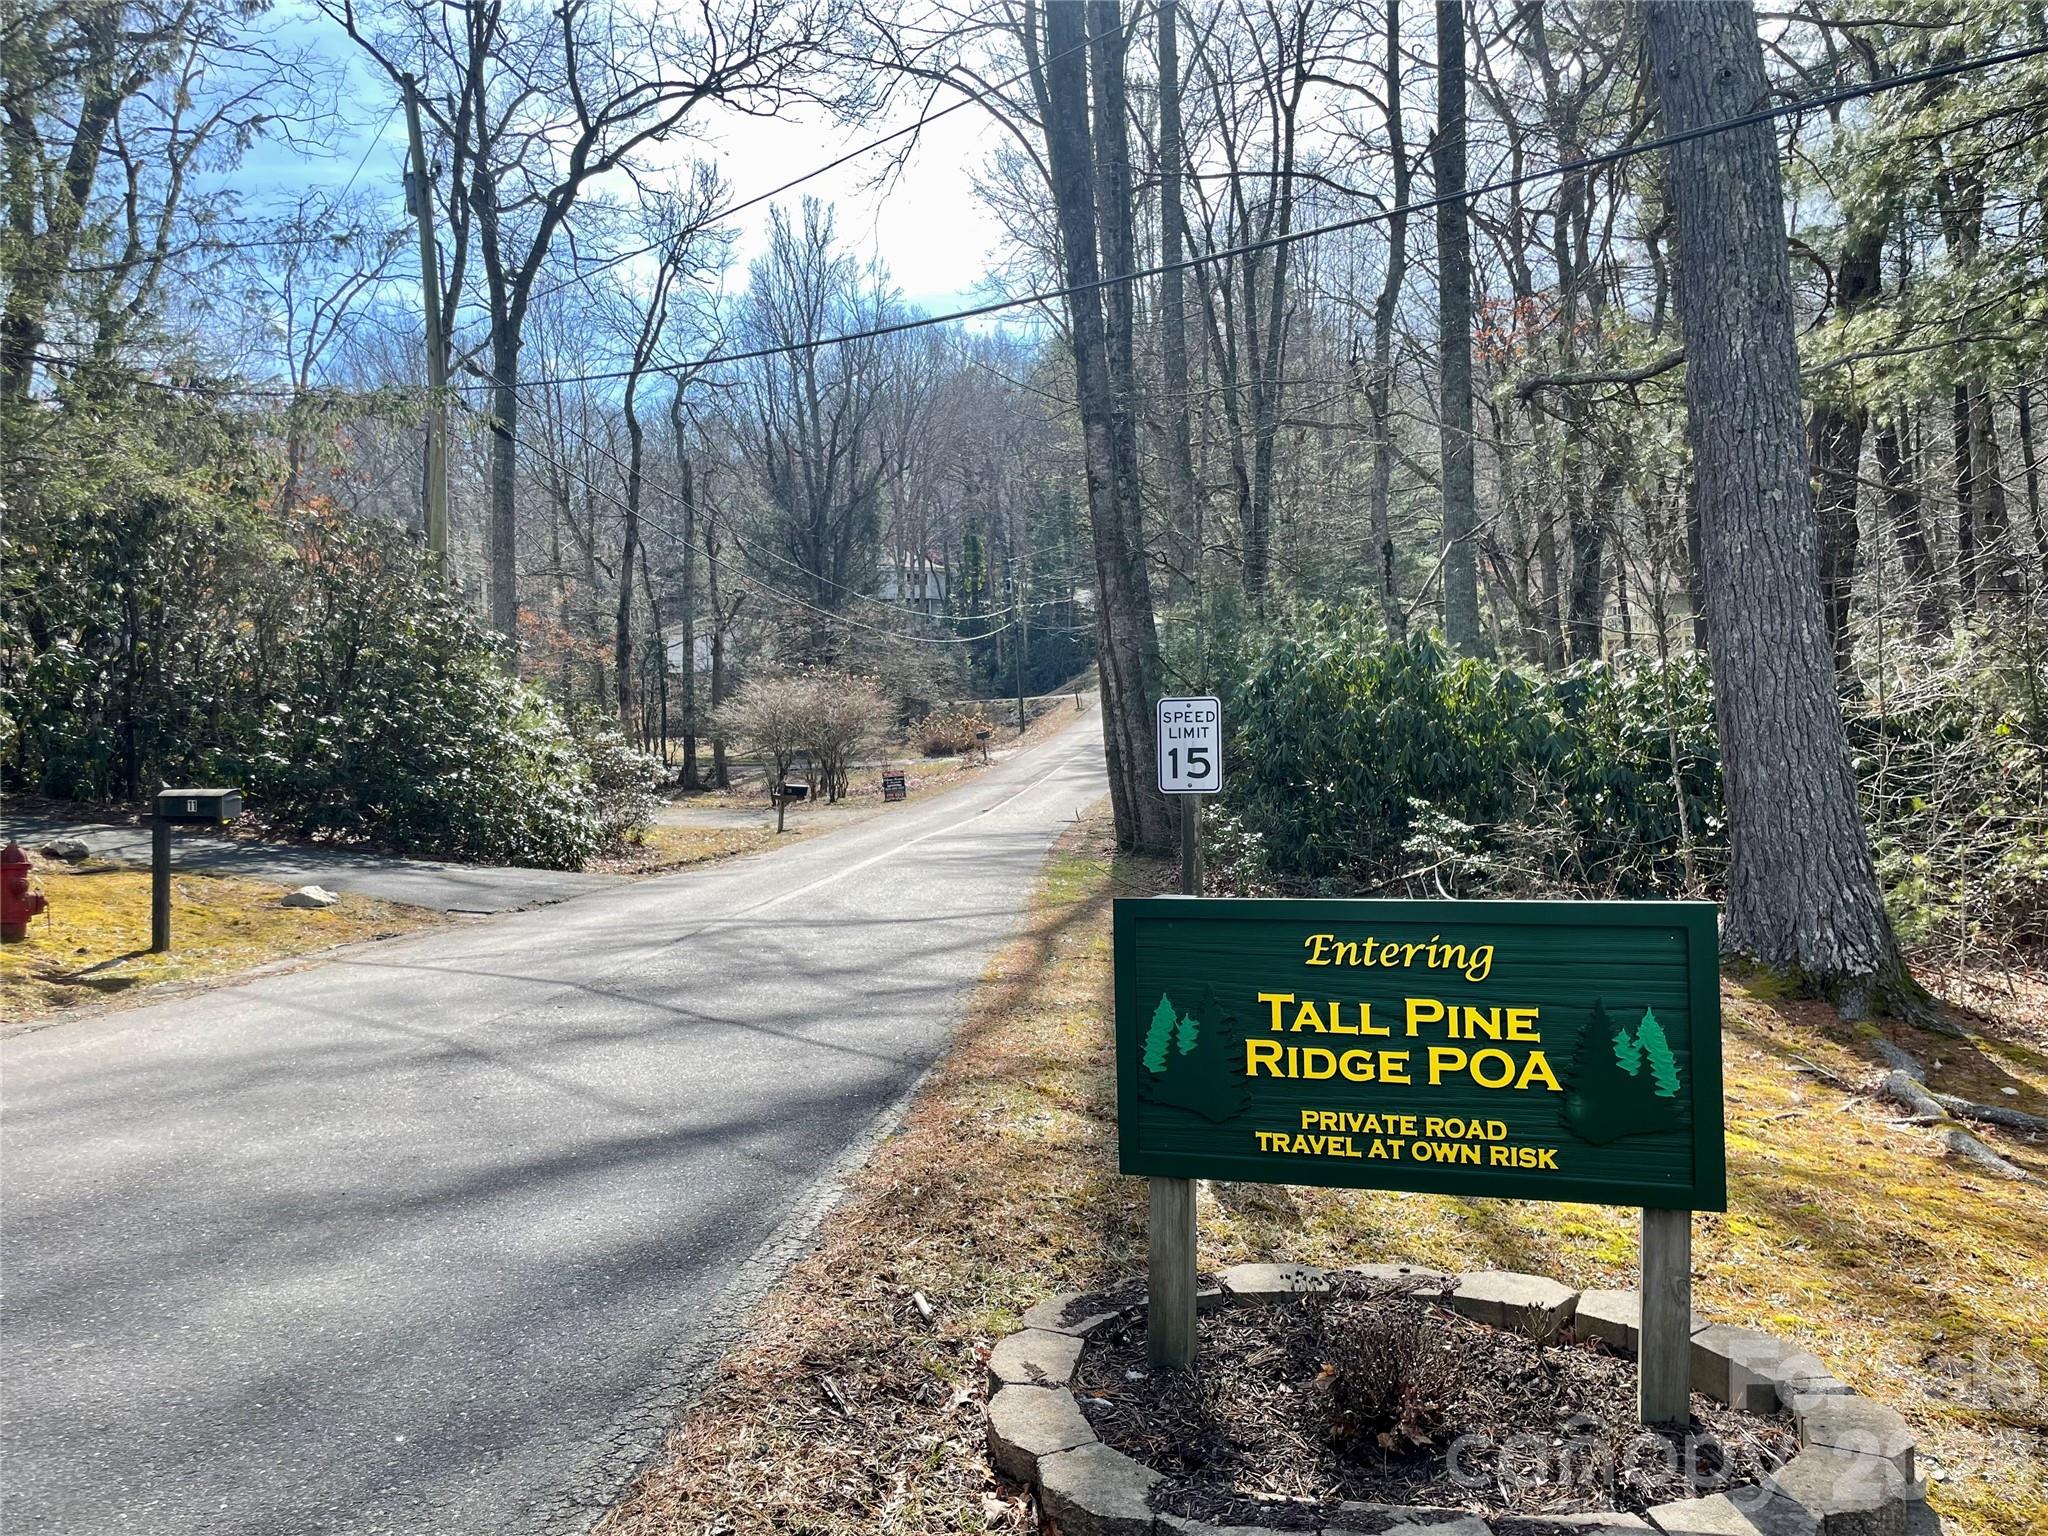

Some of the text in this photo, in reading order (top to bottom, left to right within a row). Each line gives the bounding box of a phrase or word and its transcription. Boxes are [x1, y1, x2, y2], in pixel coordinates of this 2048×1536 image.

[1163, 711, 1216, 723] SPEED
[1169, 727, 1209, 739] LIMIT
[1168, 747, 1211, 779] 15
[1304, 933, 1495, 982] Entering
[1257, 991, 1541, 1043] TALL PINE
[1244, 1039, 1564, 1092] RIDGE POA
[1301, 1109, 1508, 1142] PRIVATE ROAD
[1255, 1131, 1560, 1171] TRAVEL AT OWN RISK
